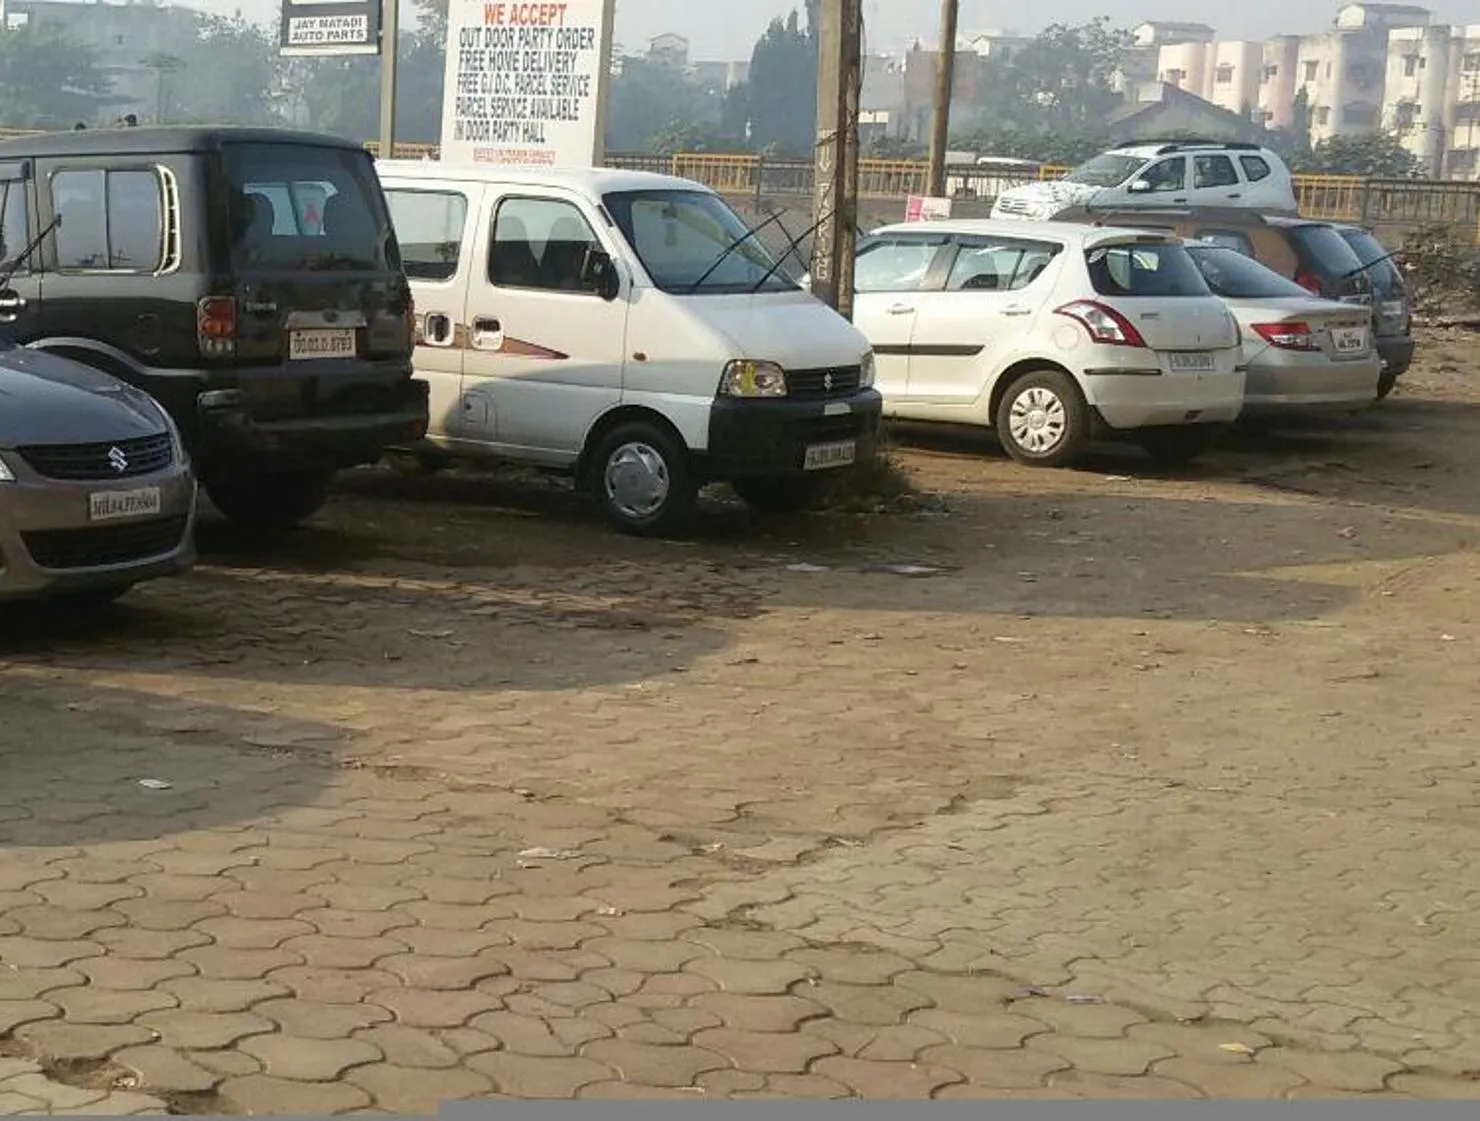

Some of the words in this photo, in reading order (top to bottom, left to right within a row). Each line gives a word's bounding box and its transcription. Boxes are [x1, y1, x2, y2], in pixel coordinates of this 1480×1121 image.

[294, 19, 317, 29] JAY
[484, 3, 506, 25] WE
[509, 3, 567, 26] ACCEPT
[292, 30, 323, 41] AUTO
[327, 29, 364, 40] PARTS
[459, 27, 482, 48] OUT
[485, 27, 515, 48] DOOR
[519, 28, 554, 49] PARTY
[556, 27, 595, 49] ORDER
[458, 50, 485, 71] FREE
[488, 51, 519, 71] HOME
[522, 51, 577, 73] DELIVERY
[457, 73, 479, 93] FREE
[514, 74, 547, 95] PARCEL
[550, 74, 590, 97] SERVICE
[455, 96, 487, 118] PARCEL
[490, 97, 527, 119] SERVICE
[530, 98, 579, 121] AVAILABLE
[465, 120, 490, 141] DOOR
[492, 121, 520, 142] PARTY
[522, 121, 546, 143] HALL
